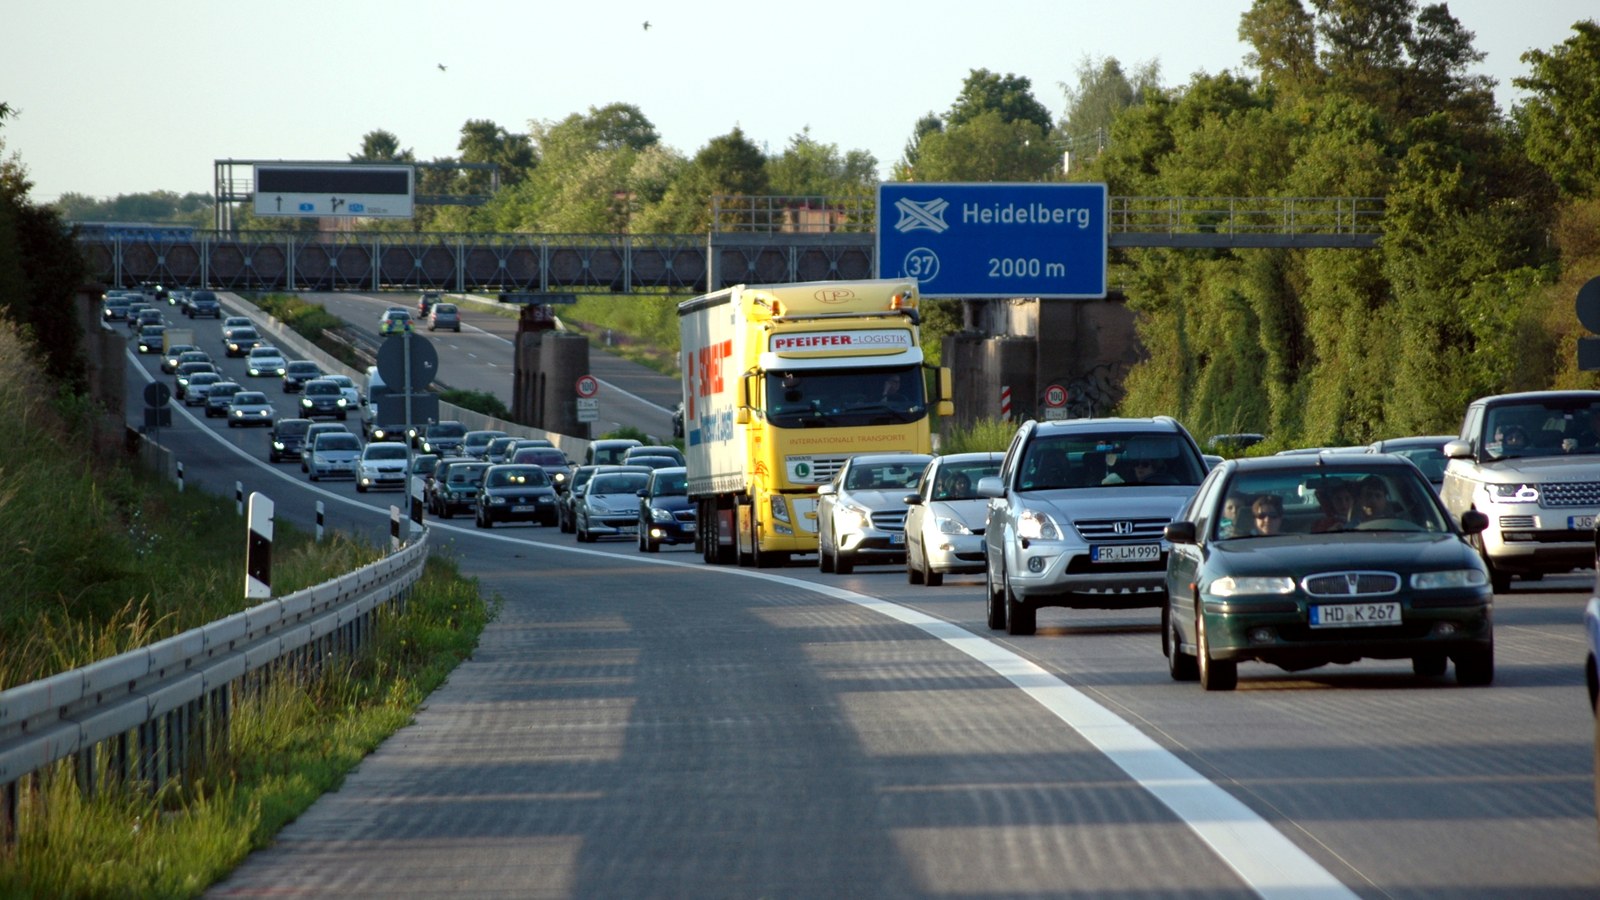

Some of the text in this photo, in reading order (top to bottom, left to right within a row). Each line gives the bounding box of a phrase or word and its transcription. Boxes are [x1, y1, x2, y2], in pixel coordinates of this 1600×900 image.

[962, 202, 1090, 229] Heidelberg
[909, 255, 934, 275] 37
[988, 258, 1065, 277] 2000 m
[789, 434, 906, 445] INTERNATIONALE TRANSPORTE
[798, 465, 807, 476] L
[1099, 546, 1158, 559] FR LM 999
[1324, 605, 1395, 621] HD K 267
